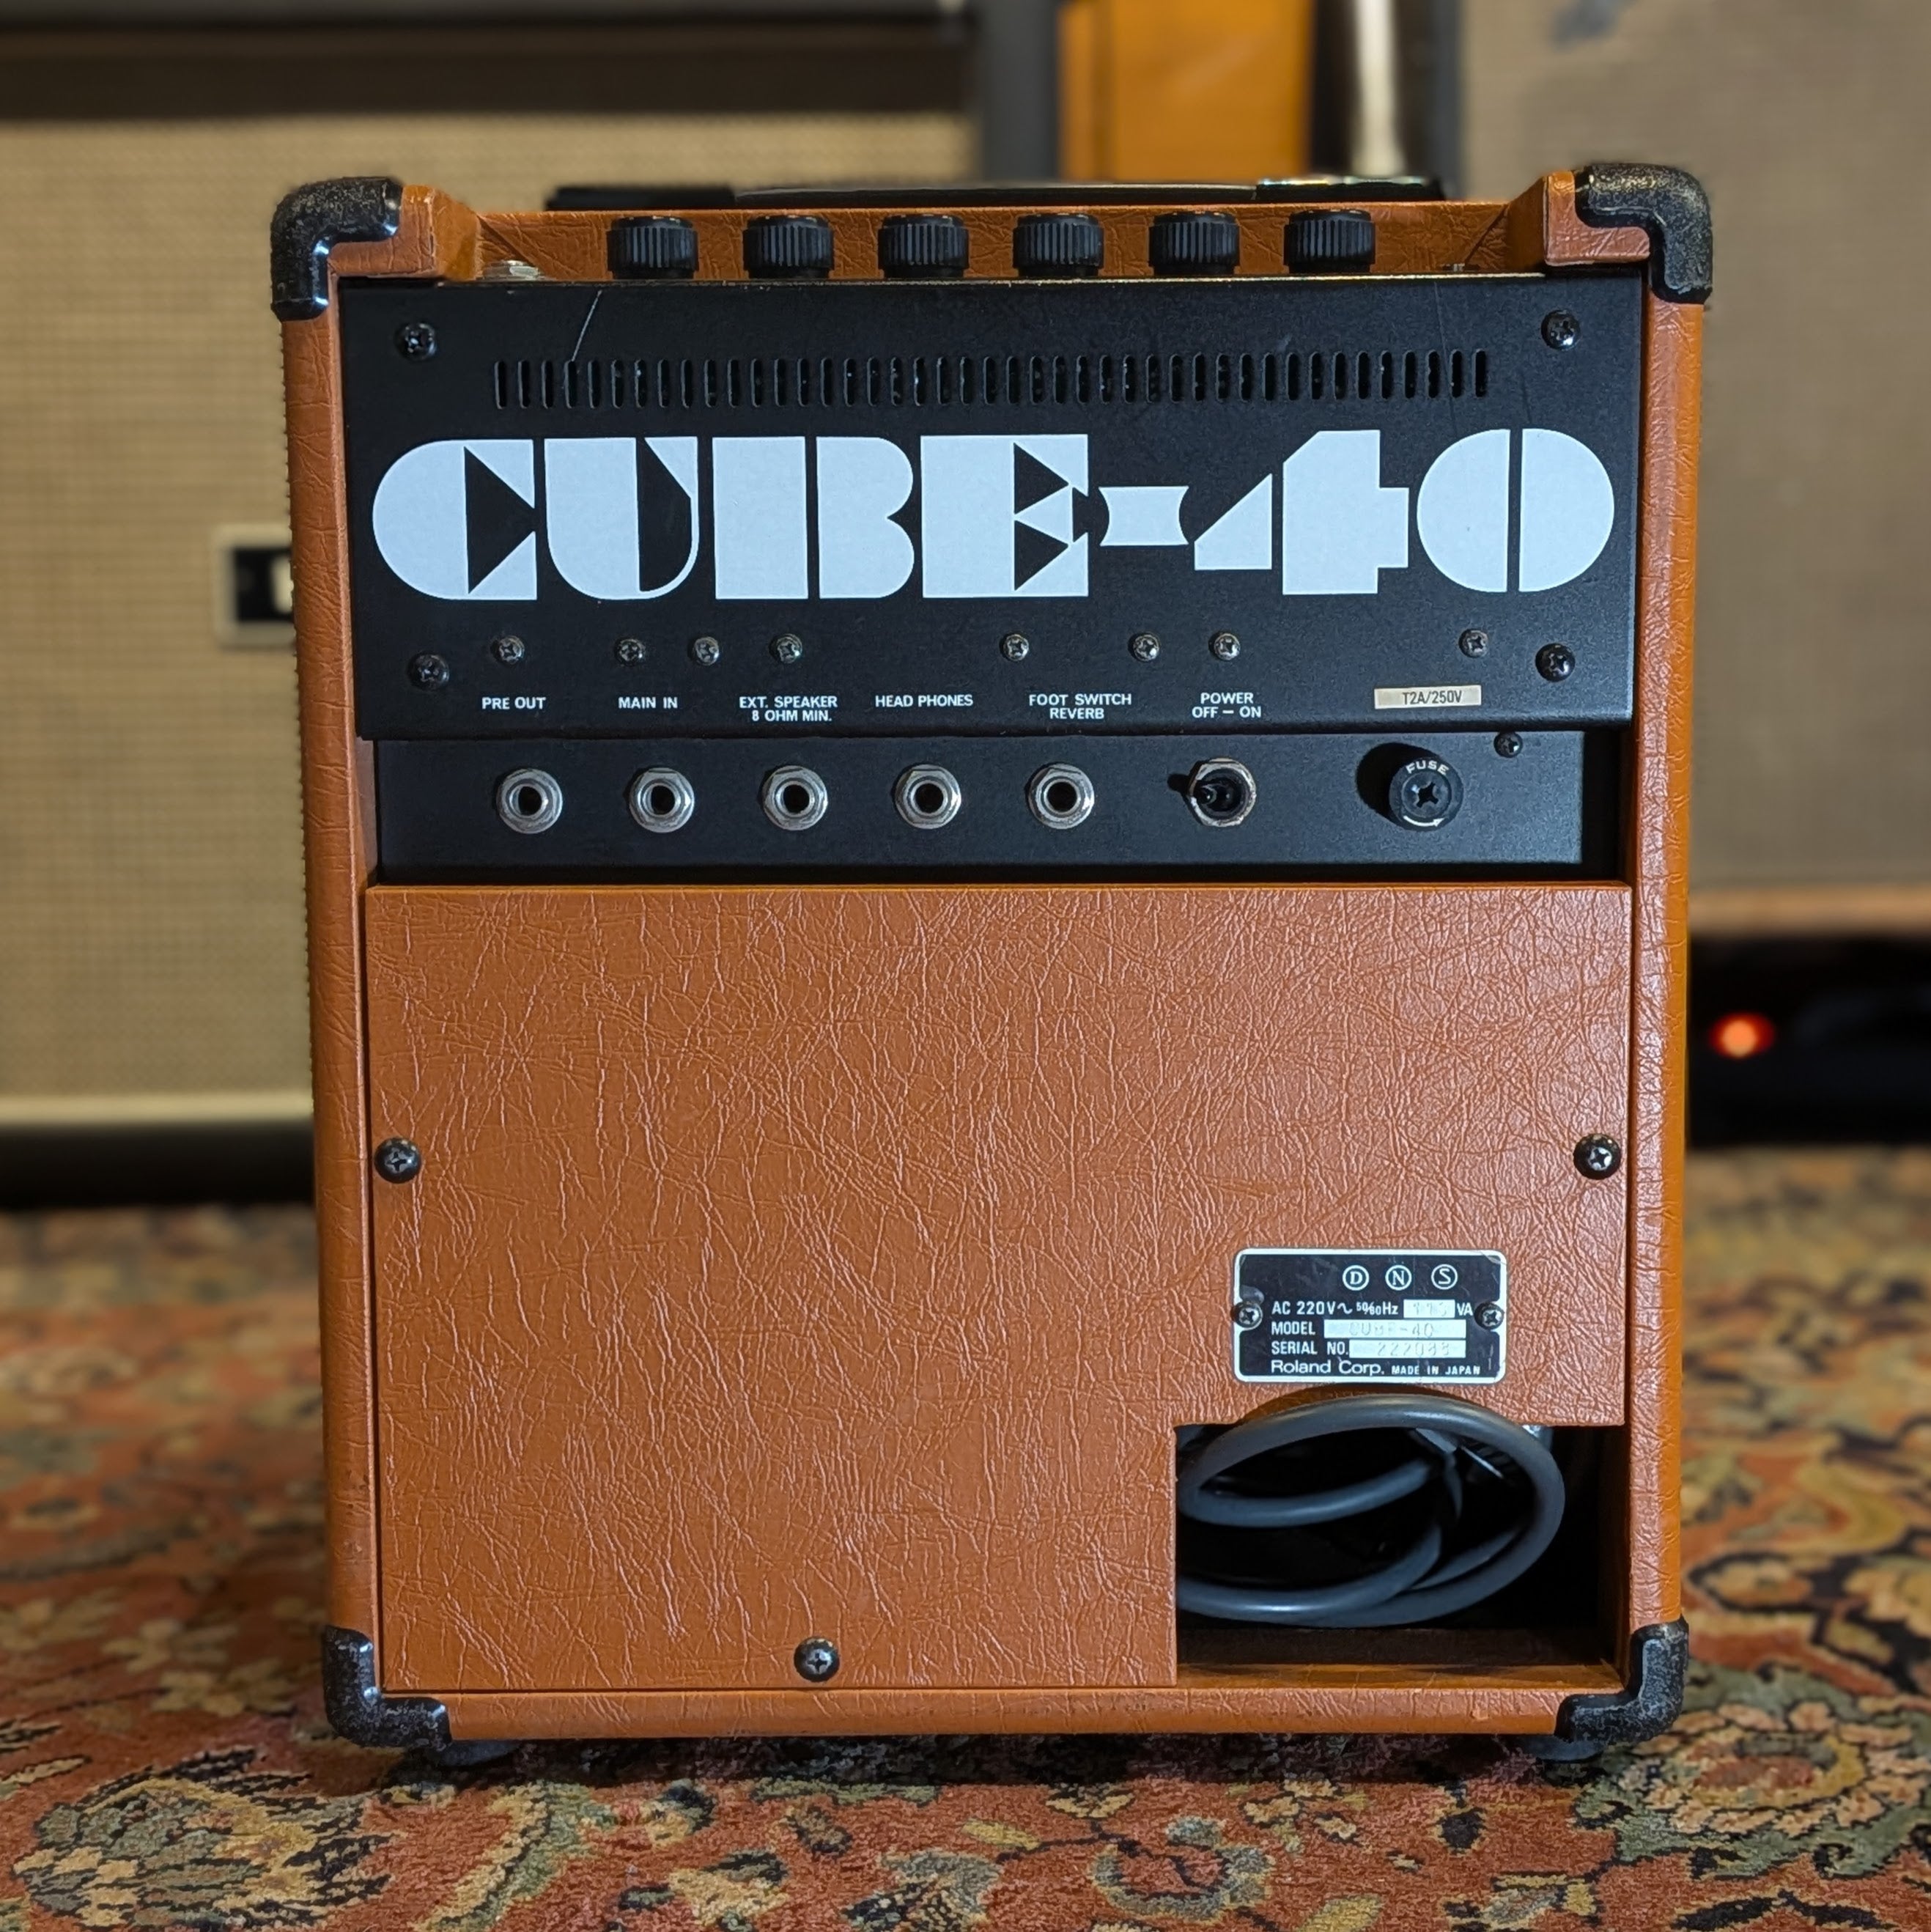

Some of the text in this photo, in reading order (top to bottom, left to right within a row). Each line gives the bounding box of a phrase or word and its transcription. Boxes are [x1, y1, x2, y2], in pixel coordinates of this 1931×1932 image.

[372, 428, 1615, 600] CUBE-40
[481, 696, 547, 710] PRE OUT
[618, 696, 678, 709] MAIN IN
[739, 695, 838, 709] EXT. SPEAKER
[875, 693, 974, 707] HEAD PHONES
[1028, 693, 1132, 707] FOOT SWITCH
[1200, 691, 1254, 705] POWER
[1402, 690, 1462, 705] T2A/250V
[751, 709, 832, 722] 8 OHM MIN.
[1049, 707, 1105, 720] REVERB
[1192, 706, 1219, 718] OFF
[1238, 705, 1262, 718] ON
[1406, 760, 1450, 775] FUSE
[1271, 1300, 1291, 1315] AC
[1456, 1302, 1474, 1316] VA
[1271, 1321, 1316, 1335] MODEL
[1271, 1341, 1318, 1355] SERIAL
[1326, 1341, 1349, 1355] NO.
[1271, 1359, 1480, 1377] Roland Corp. MADE IN JAPAN
